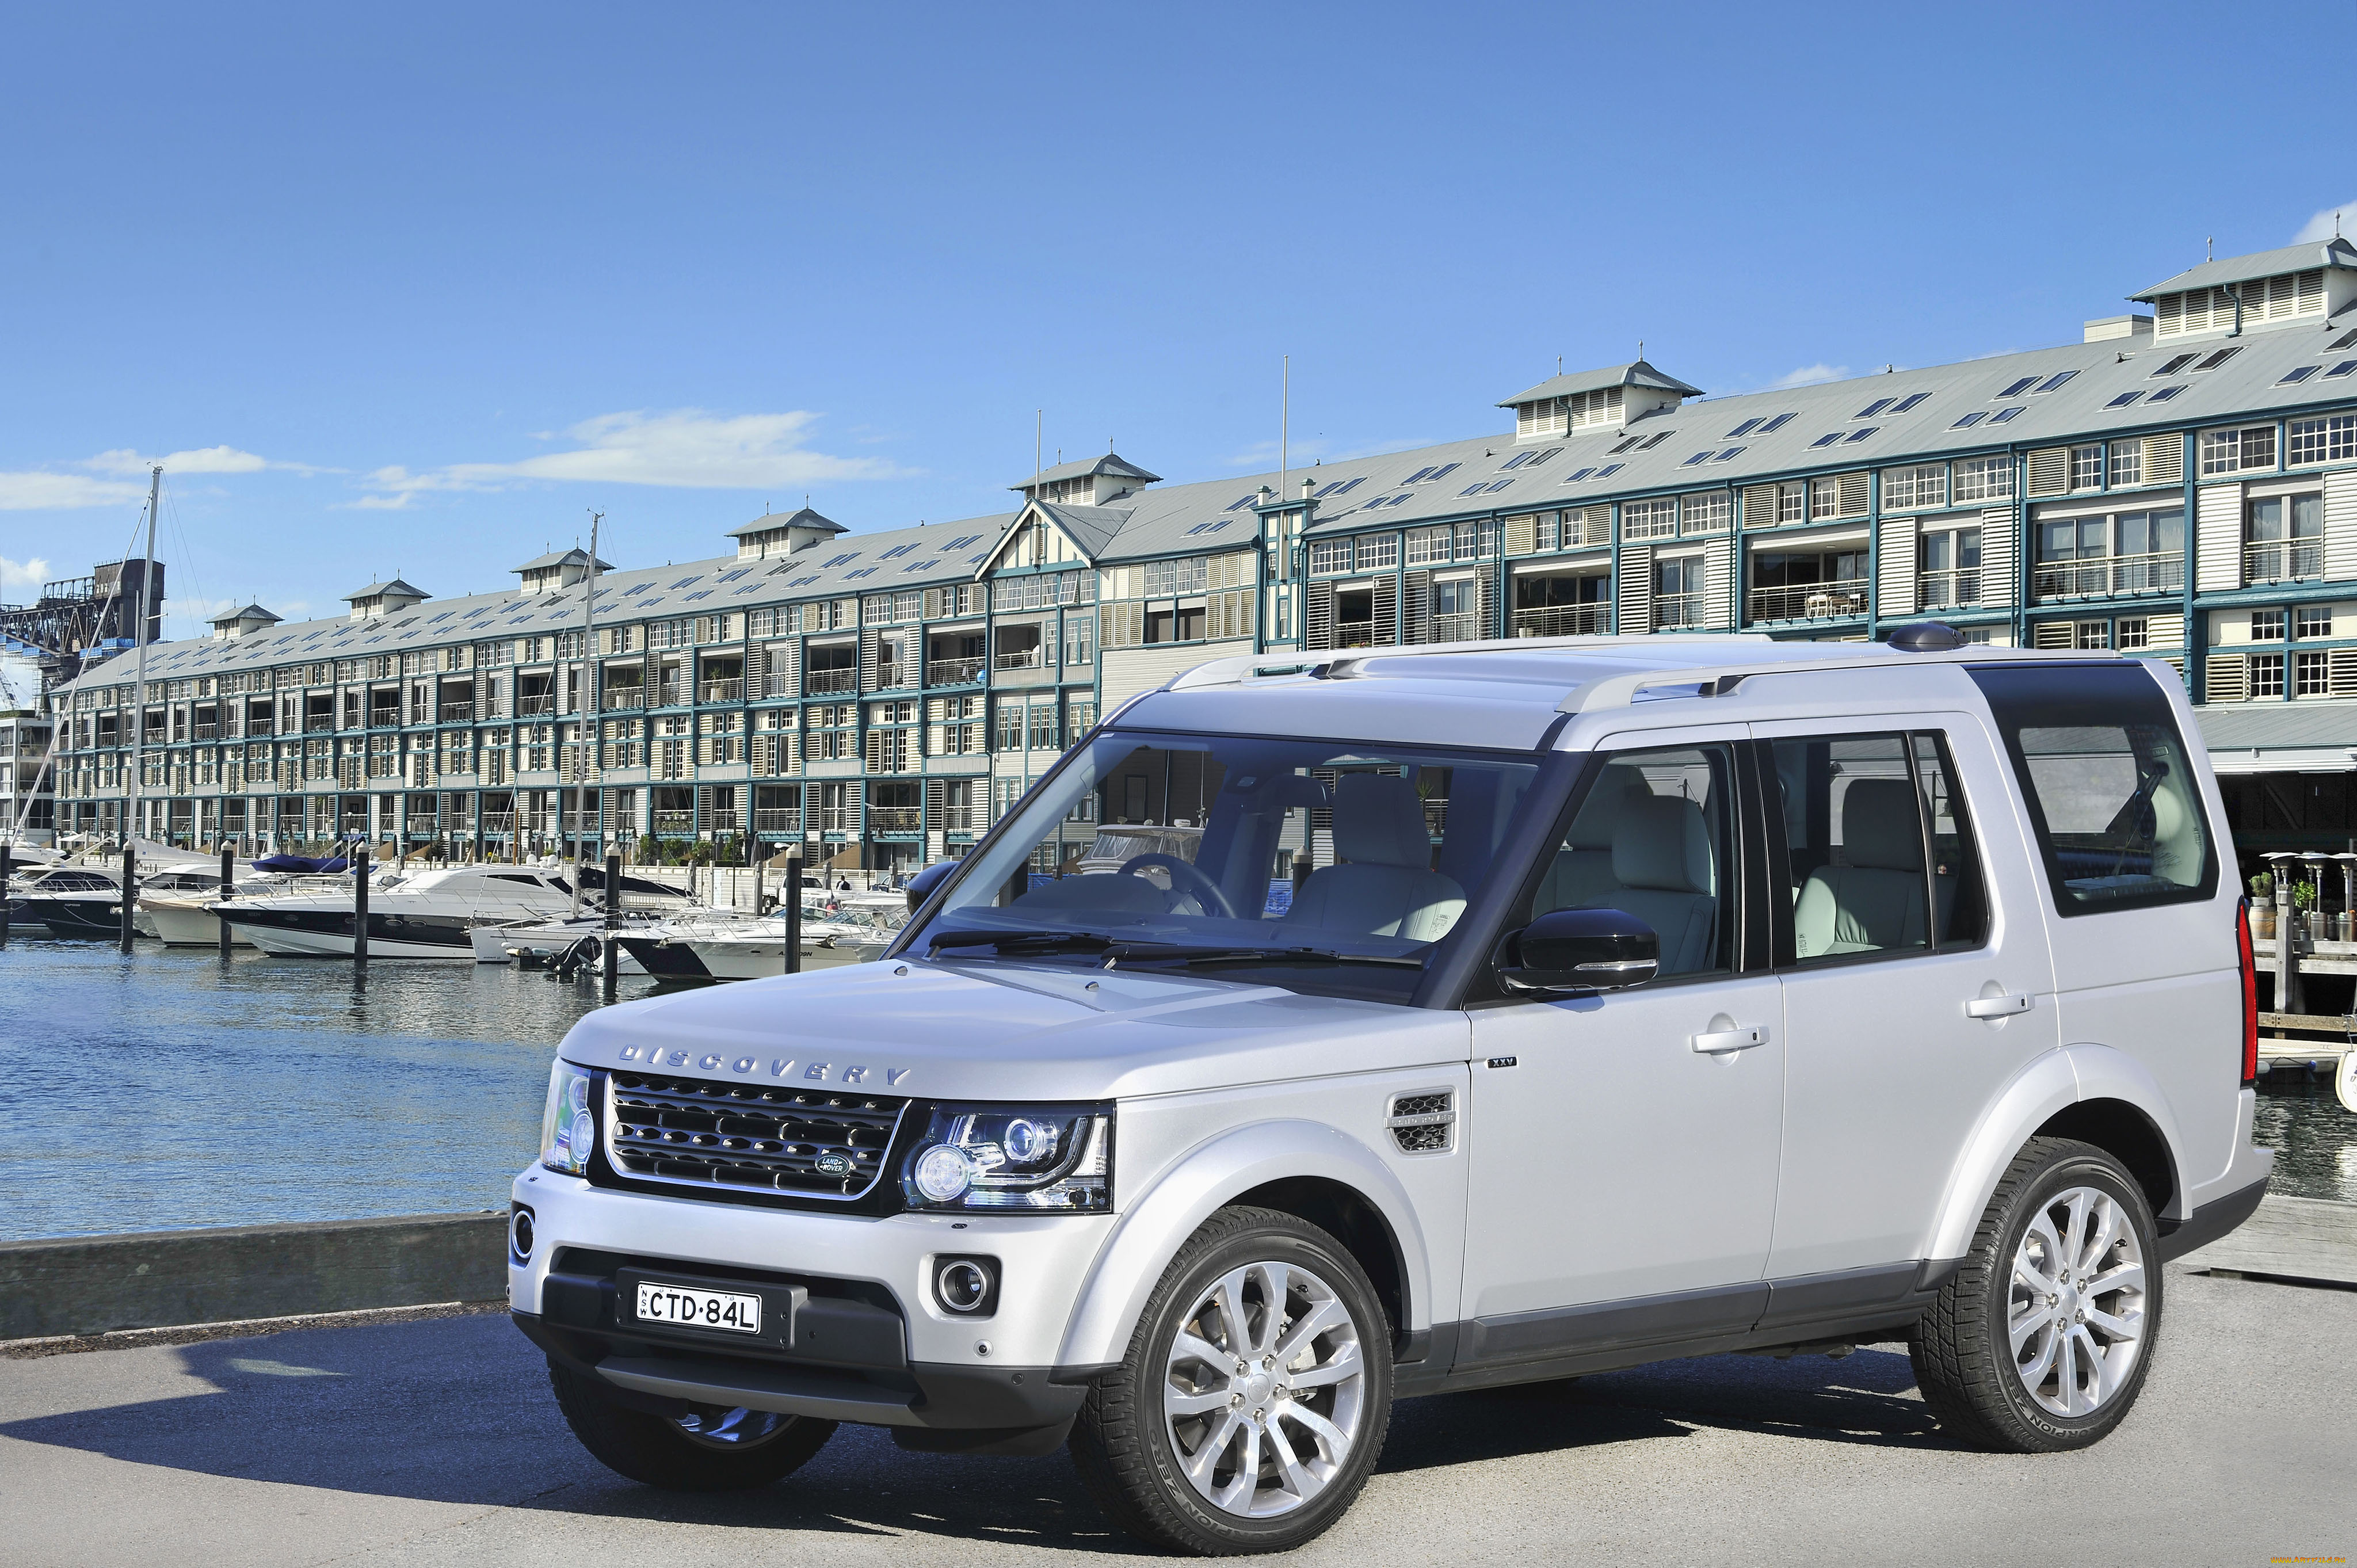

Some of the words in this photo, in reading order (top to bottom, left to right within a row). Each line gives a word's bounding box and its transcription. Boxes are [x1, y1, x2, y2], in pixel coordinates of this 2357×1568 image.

[619, 1044, 910, 1086] DISCOVERY
[1493, 1058, 1513, 1066] XXV
[2002, 1357, 2029, 1412] ZERO
[1151, 1429, 1181, 1497] ZERO
